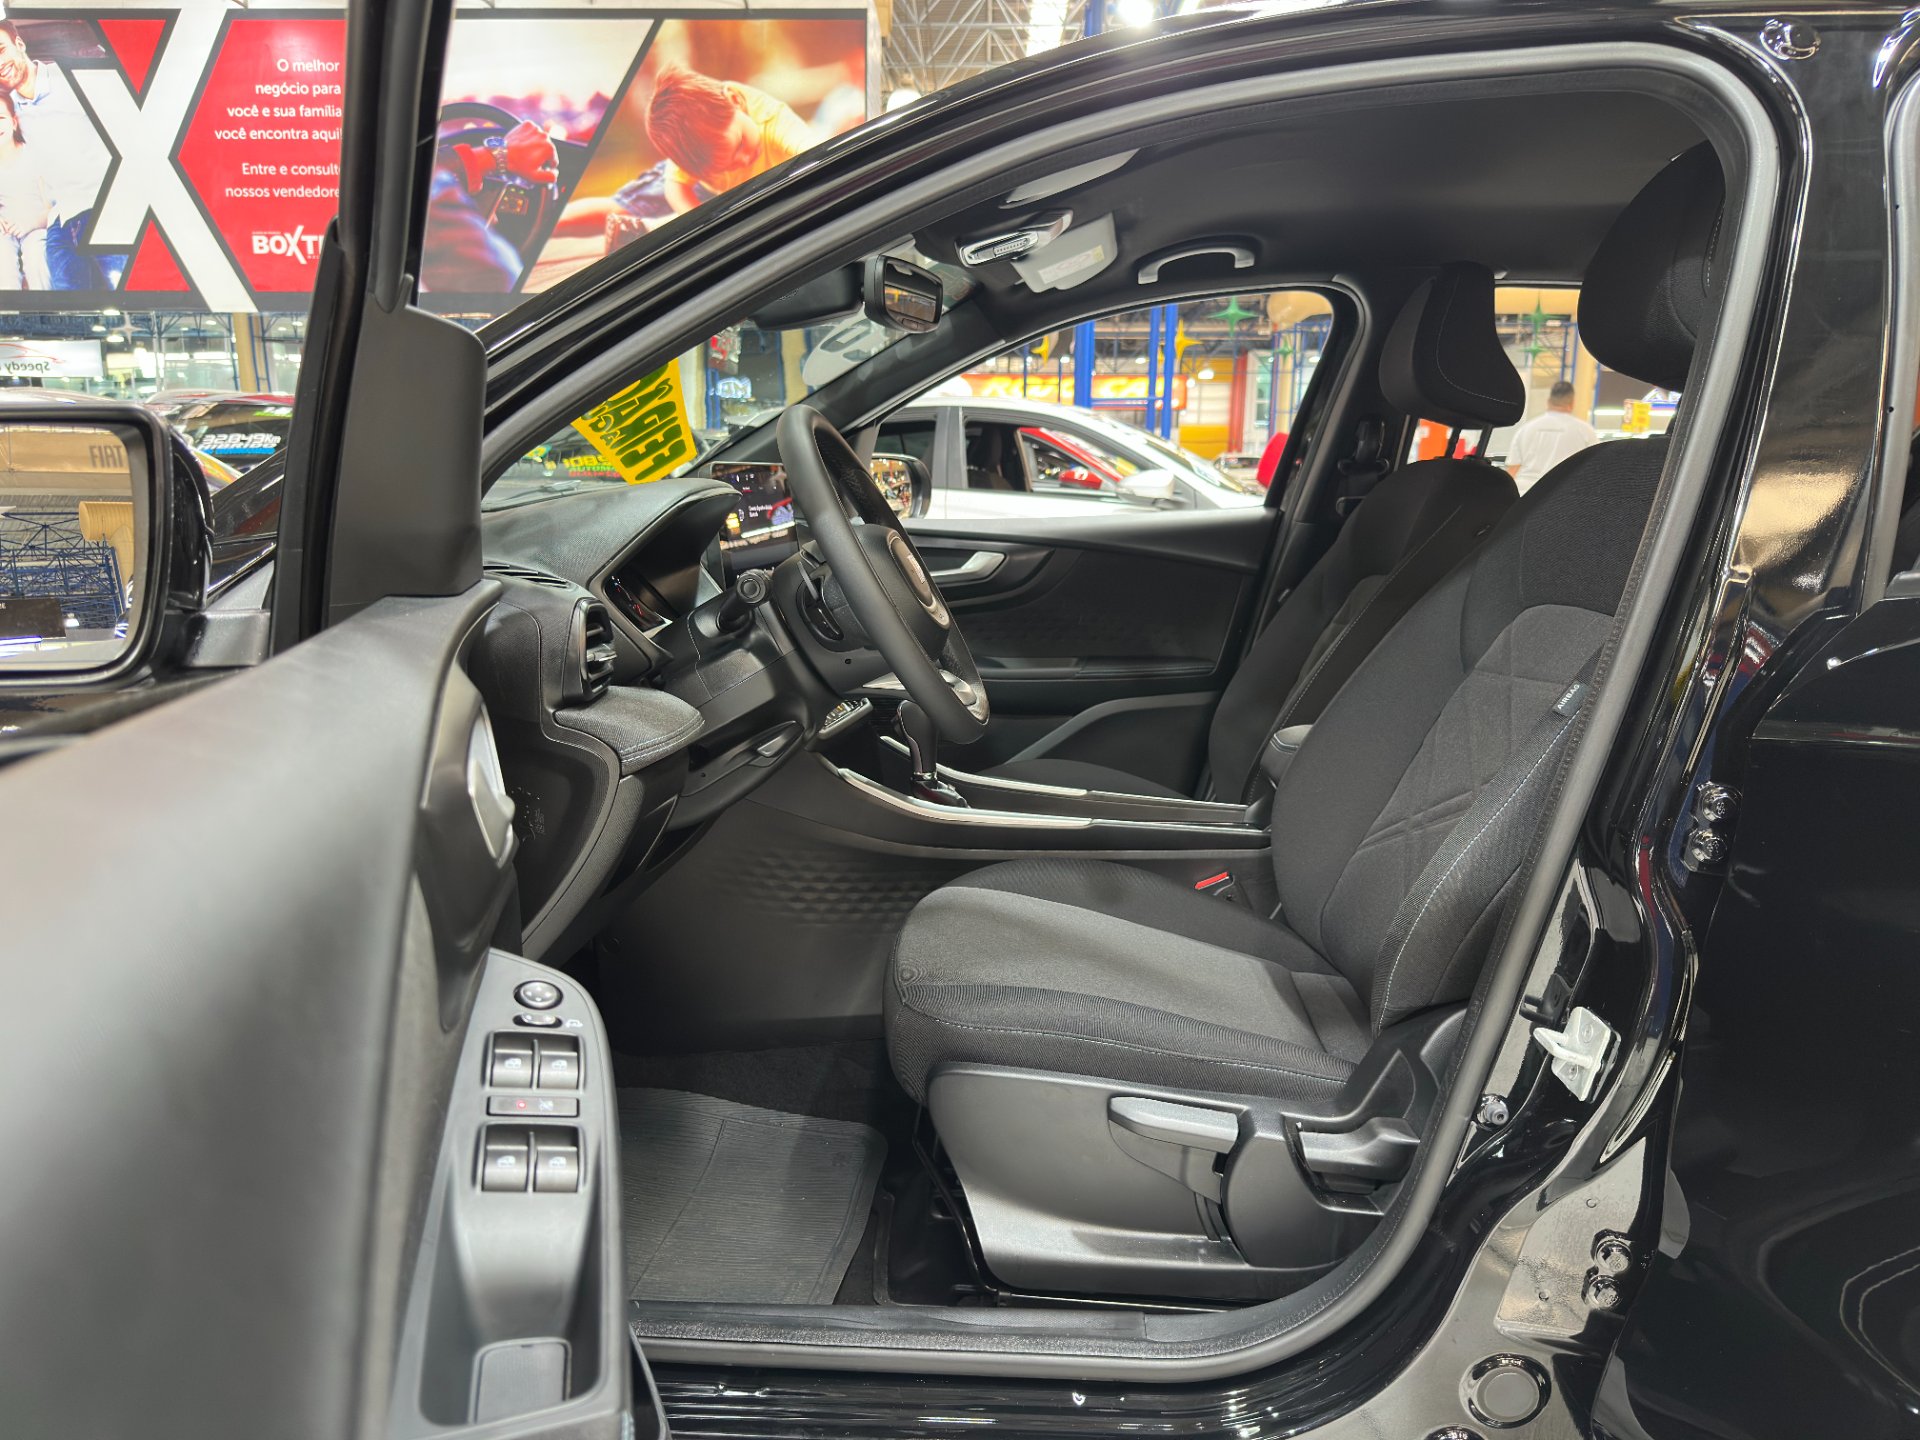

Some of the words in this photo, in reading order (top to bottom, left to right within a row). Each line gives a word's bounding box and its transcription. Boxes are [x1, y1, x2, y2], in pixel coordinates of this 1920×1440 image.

[276, 58, 290, 72] O
[292, 59, 340, 72] melhor
[255, 82, 309, 98] negócio
[312, 85, 342, 97] para
[226, 104, 259, 117] você
[262, 107, 270, 117] e
[273, 107, 296, 117] sua
[299, 104, 342, 117] família
[214, 127, 247, 140] você
[249, 128, 309, 140] encontra
[241, 162, 277, 175] Entre
[279, 166, 288, 175] e
[225, 187, 270, 198] nossos
[88, 445, 124, 468] FIAT
[1557, 683, 1580, 711] AIRBAG
